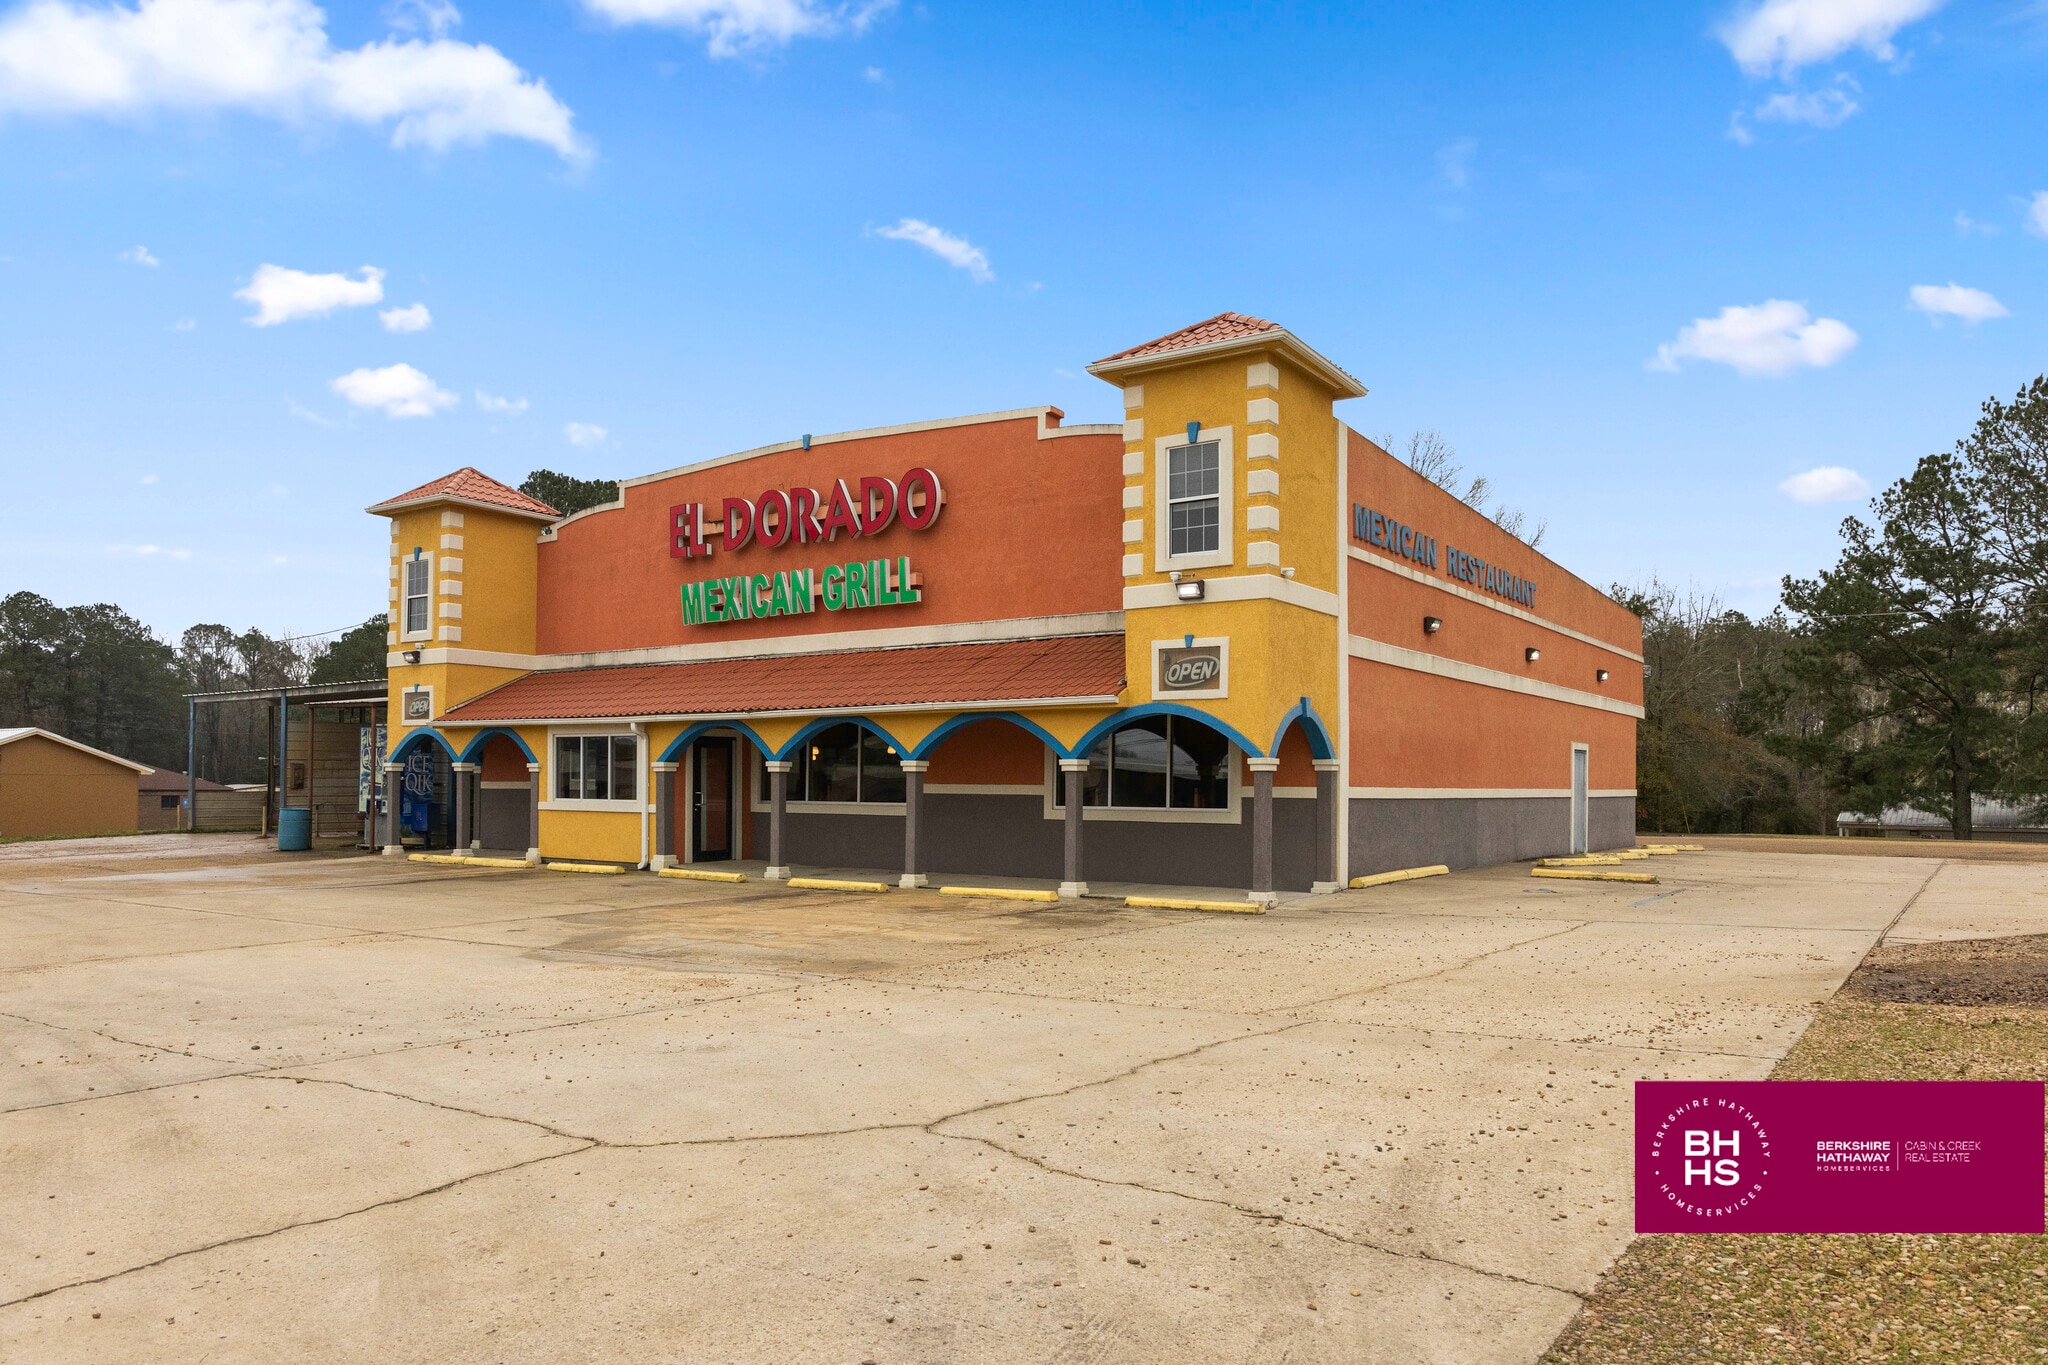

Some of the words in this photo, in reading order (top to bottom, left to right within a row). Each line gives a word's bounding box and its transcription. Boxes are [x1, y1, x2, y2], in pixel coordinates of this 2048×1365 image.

[670, 503, 711, 558] EL
[723, 468, 942, 551] DORADO
[1354, 503, 1437, 569] MEXICAN
[1447, 545, 1536, 608] RESTAURANT
[681, 569, 815, 626] MEXICAN
[821, 556, 921, 611] GRILL
[1168, 661, 1214, 682] OPEN
[410, 700, 429, 713] OPEN
[408, 755, 429, 773] ICE
[405, 772, 432, 796] QIK
